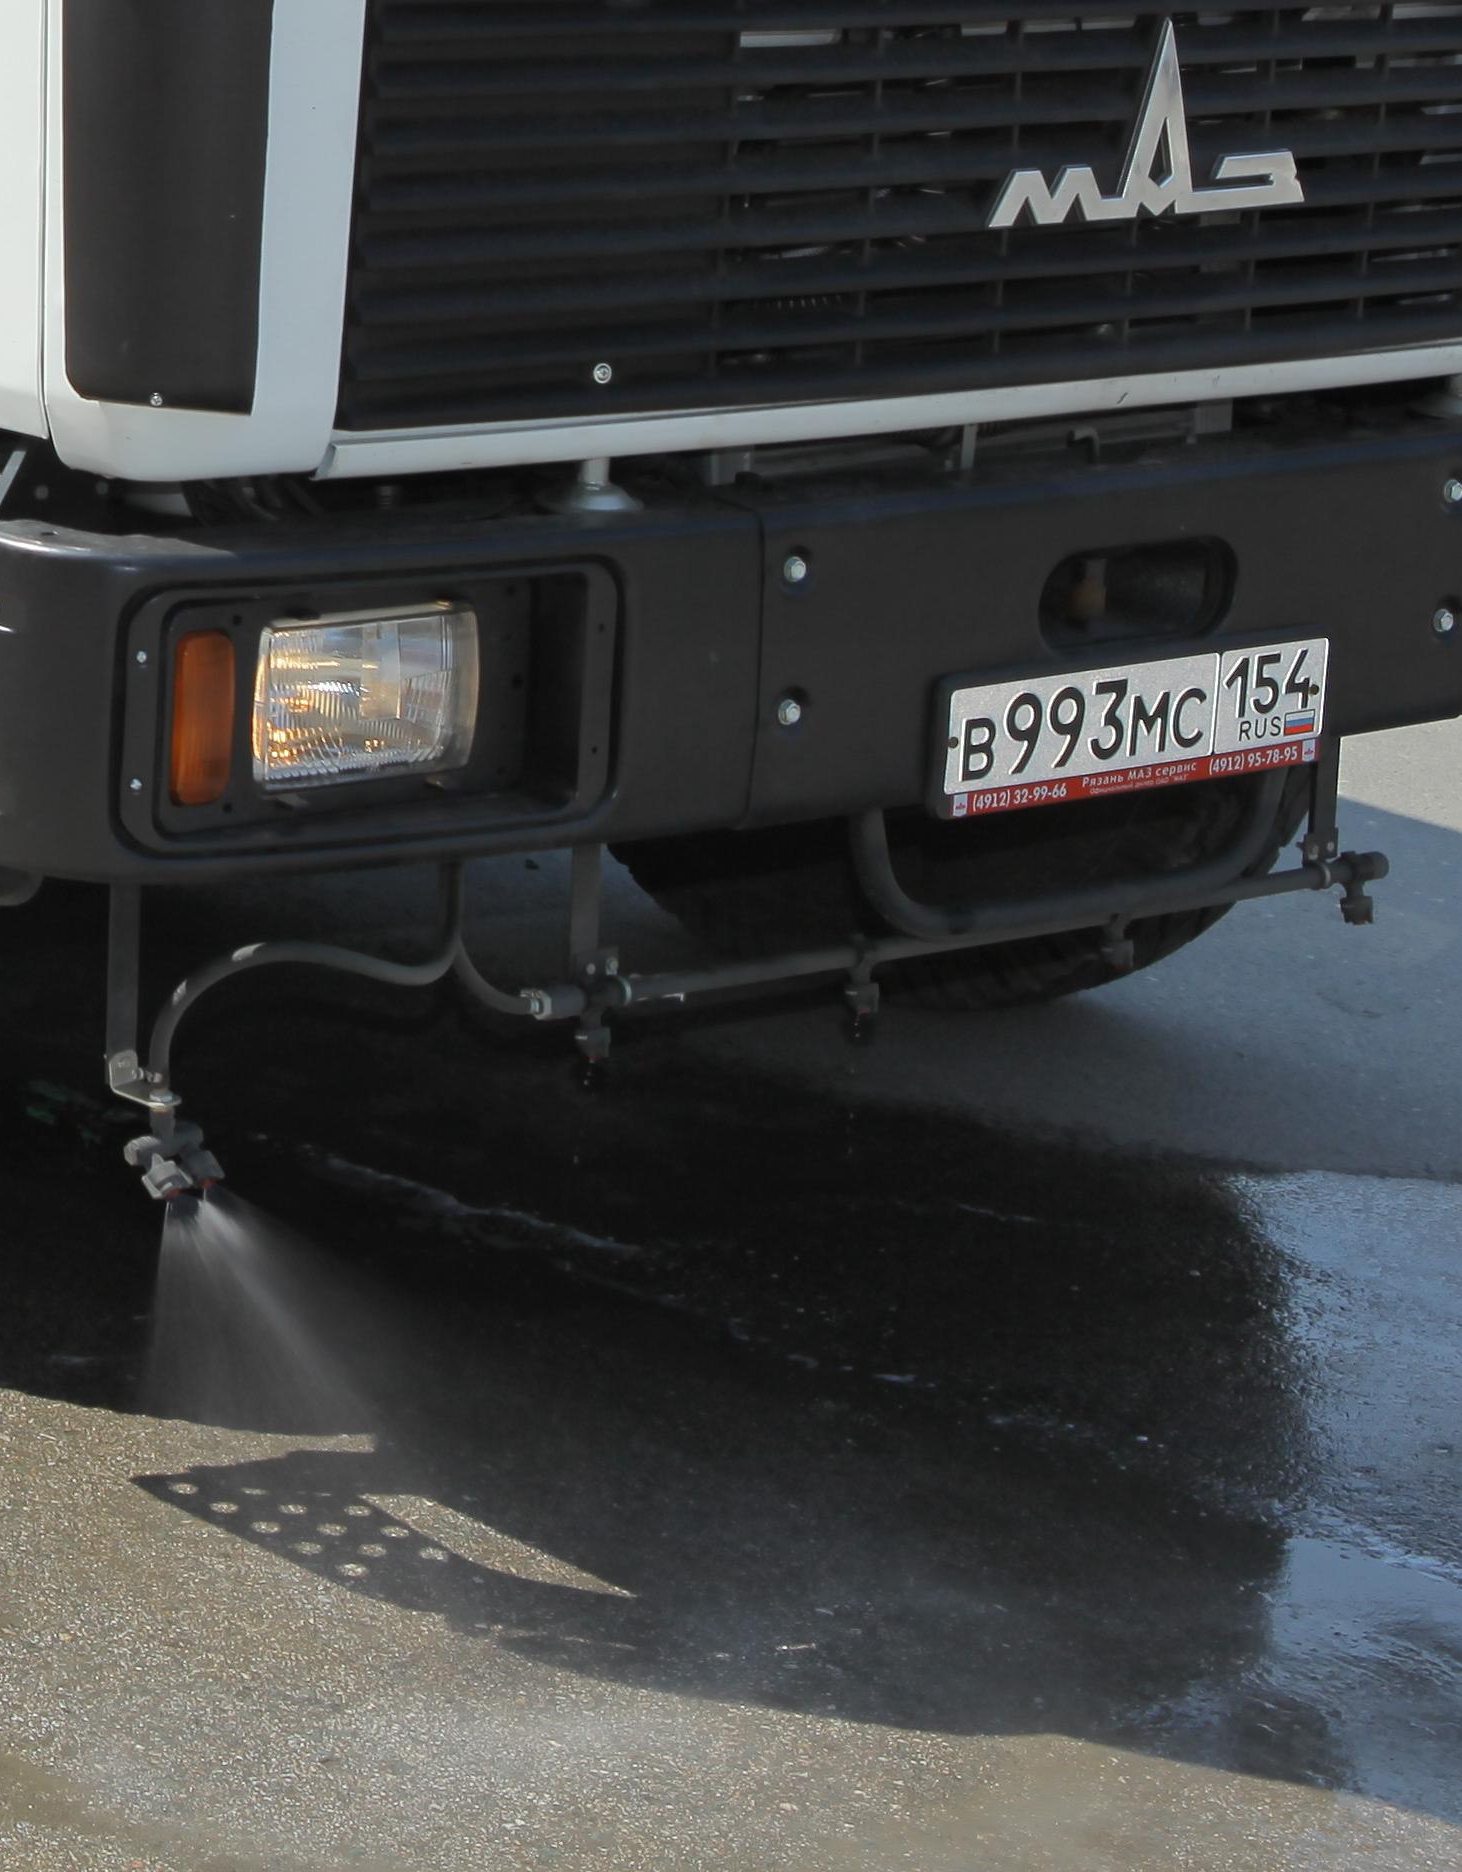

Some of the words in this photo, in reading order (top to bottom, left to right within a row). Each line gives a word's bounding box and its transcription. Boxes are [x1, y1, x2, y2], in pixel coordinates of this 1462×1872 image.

[1223, 647, 1311, 719] 154
[1237, 715, 1282, 743] RUS
[1081, 774, 1125, 789] Рязань
[1127, 768, 1153, 781] МАЗ
[1155, 762, 1198, 778] сервис
[1208, 752, 1245, 776] (4912)
[1248, 745, 1299, 766] 95-78-95
[972, 789, 1011, 813] (4912)
[1014, 782, 1068, 806] 32-99-66
